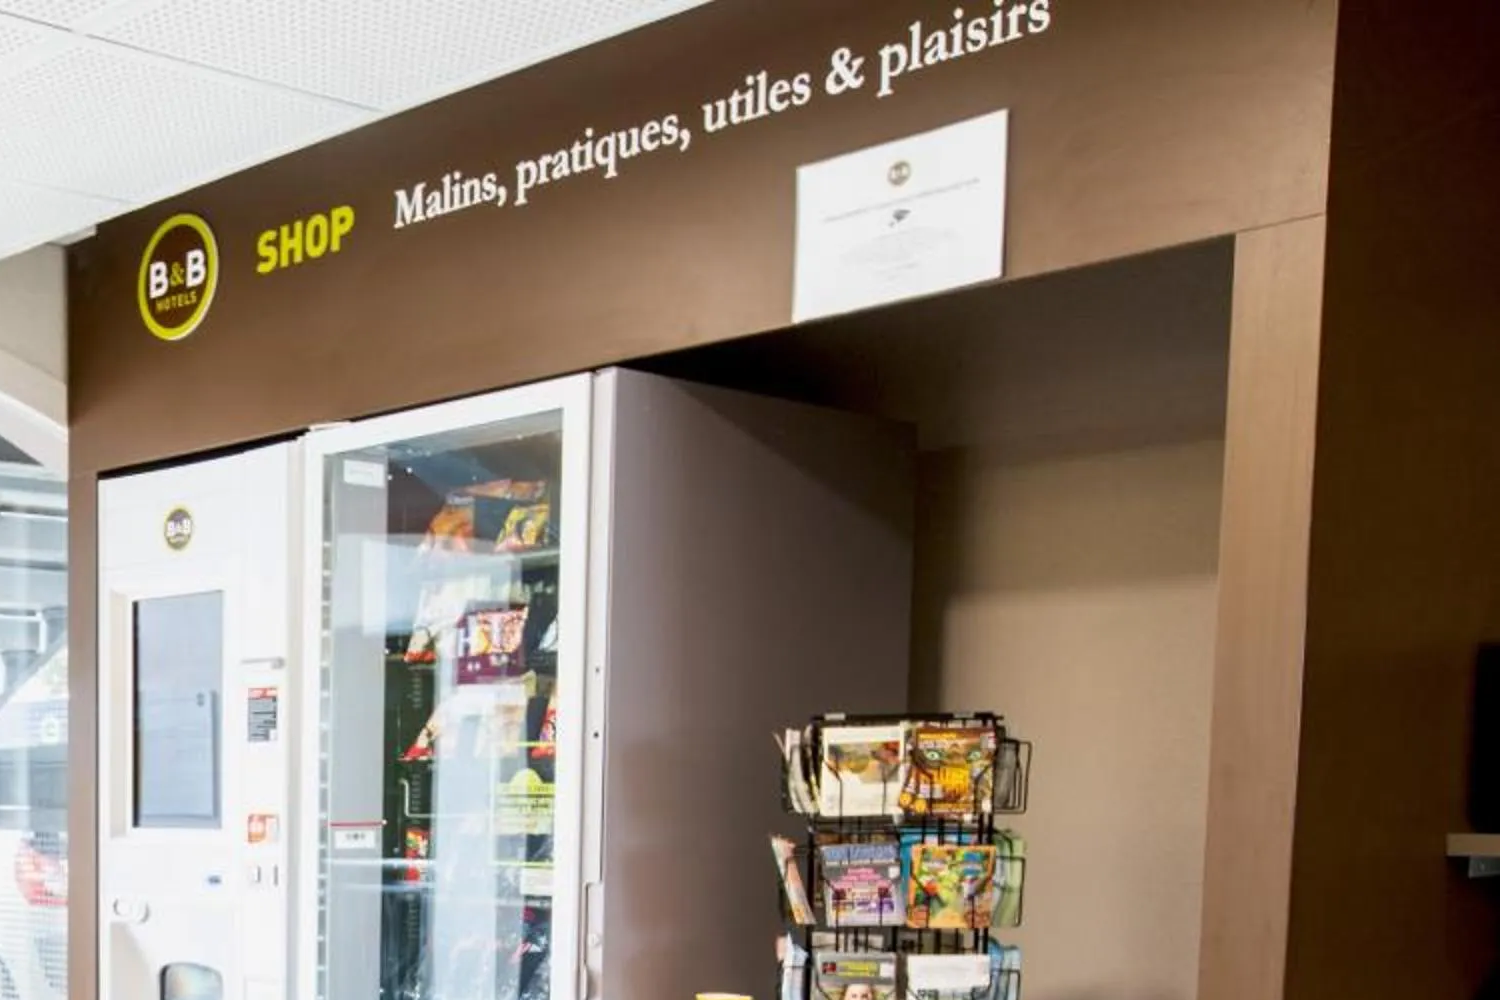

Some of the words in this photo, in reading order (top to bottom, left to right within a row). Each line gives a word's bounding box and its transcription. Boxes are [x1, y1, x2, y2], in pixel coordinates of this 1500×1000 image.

[394, 171, 507, 229] Malins,
[514, 114, 691, 206] pratiques,
[702, 71, 811, 133] utiles
[825, 47, 865, 96] &
[876, 0, 1051, 98] plaisirs
[257, 205, 355, 273] SHOP
[150, 249, 206, 299] B&B
[156, 291, 197, 313] HOTELS
